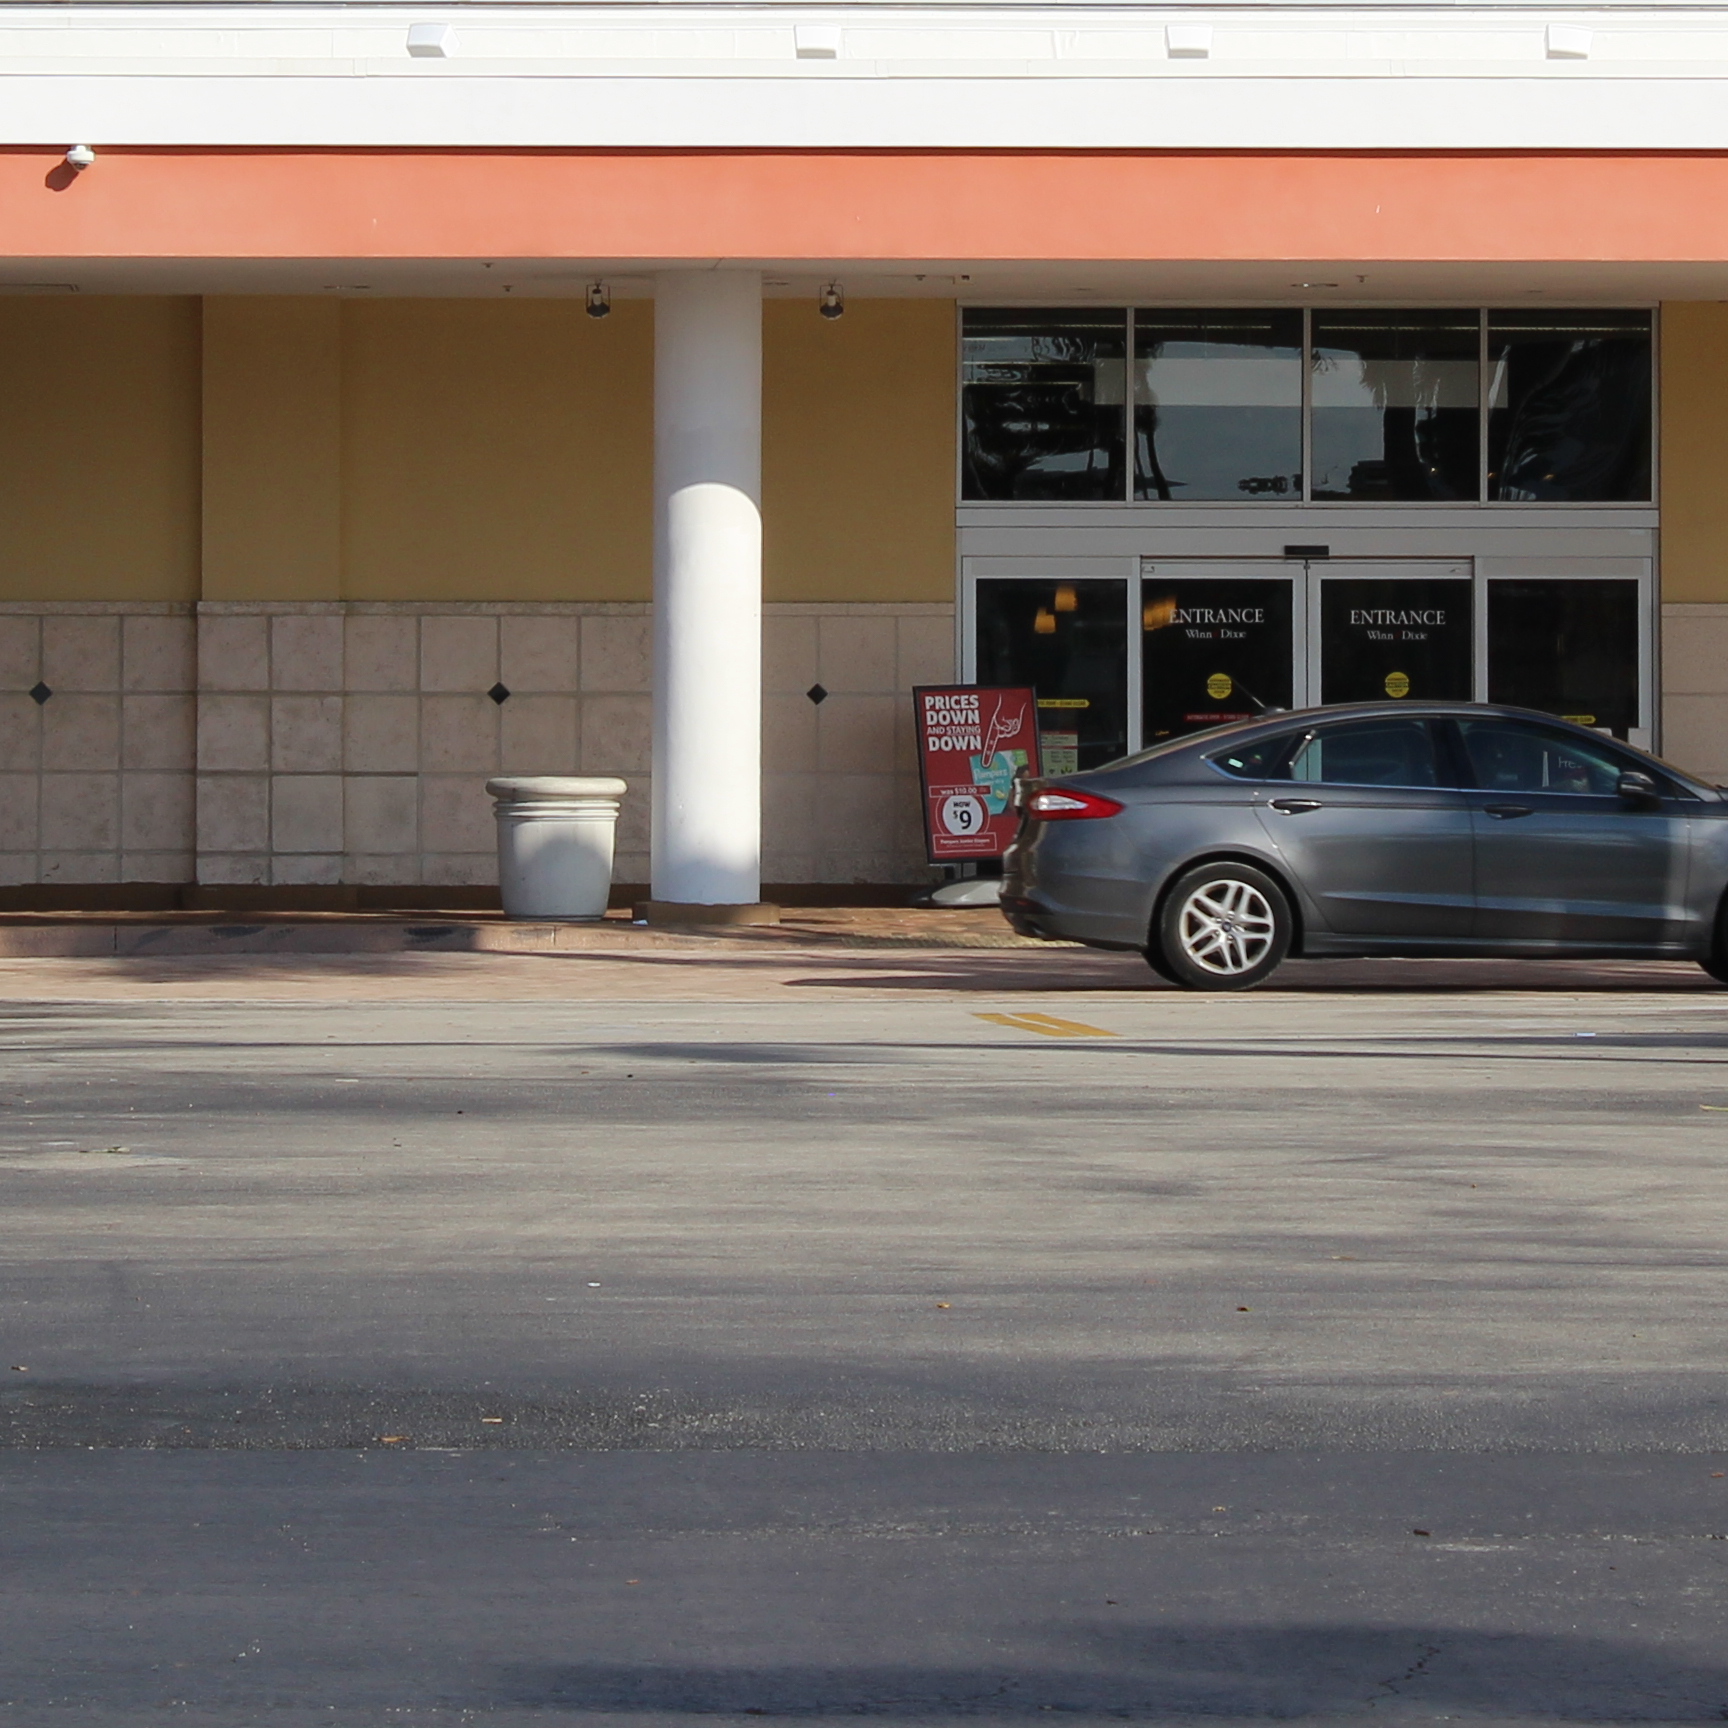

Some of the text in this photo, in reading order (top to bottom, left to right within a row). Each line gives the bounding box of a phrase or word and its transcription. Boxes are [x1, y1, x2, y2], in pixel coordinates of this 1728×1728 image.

[1169, 608, 1265, 624] ENTRANCE
[1350, 609, 1446, 625] ENTRANCE
[924, 694, 979, 710] PRICES
[926, 709, 980, 725] DOWN
[927, 725, 981, 735] AND STAYING
[928, 735, 982, 752] DOWN
[952, 810, 972, 830] $9
